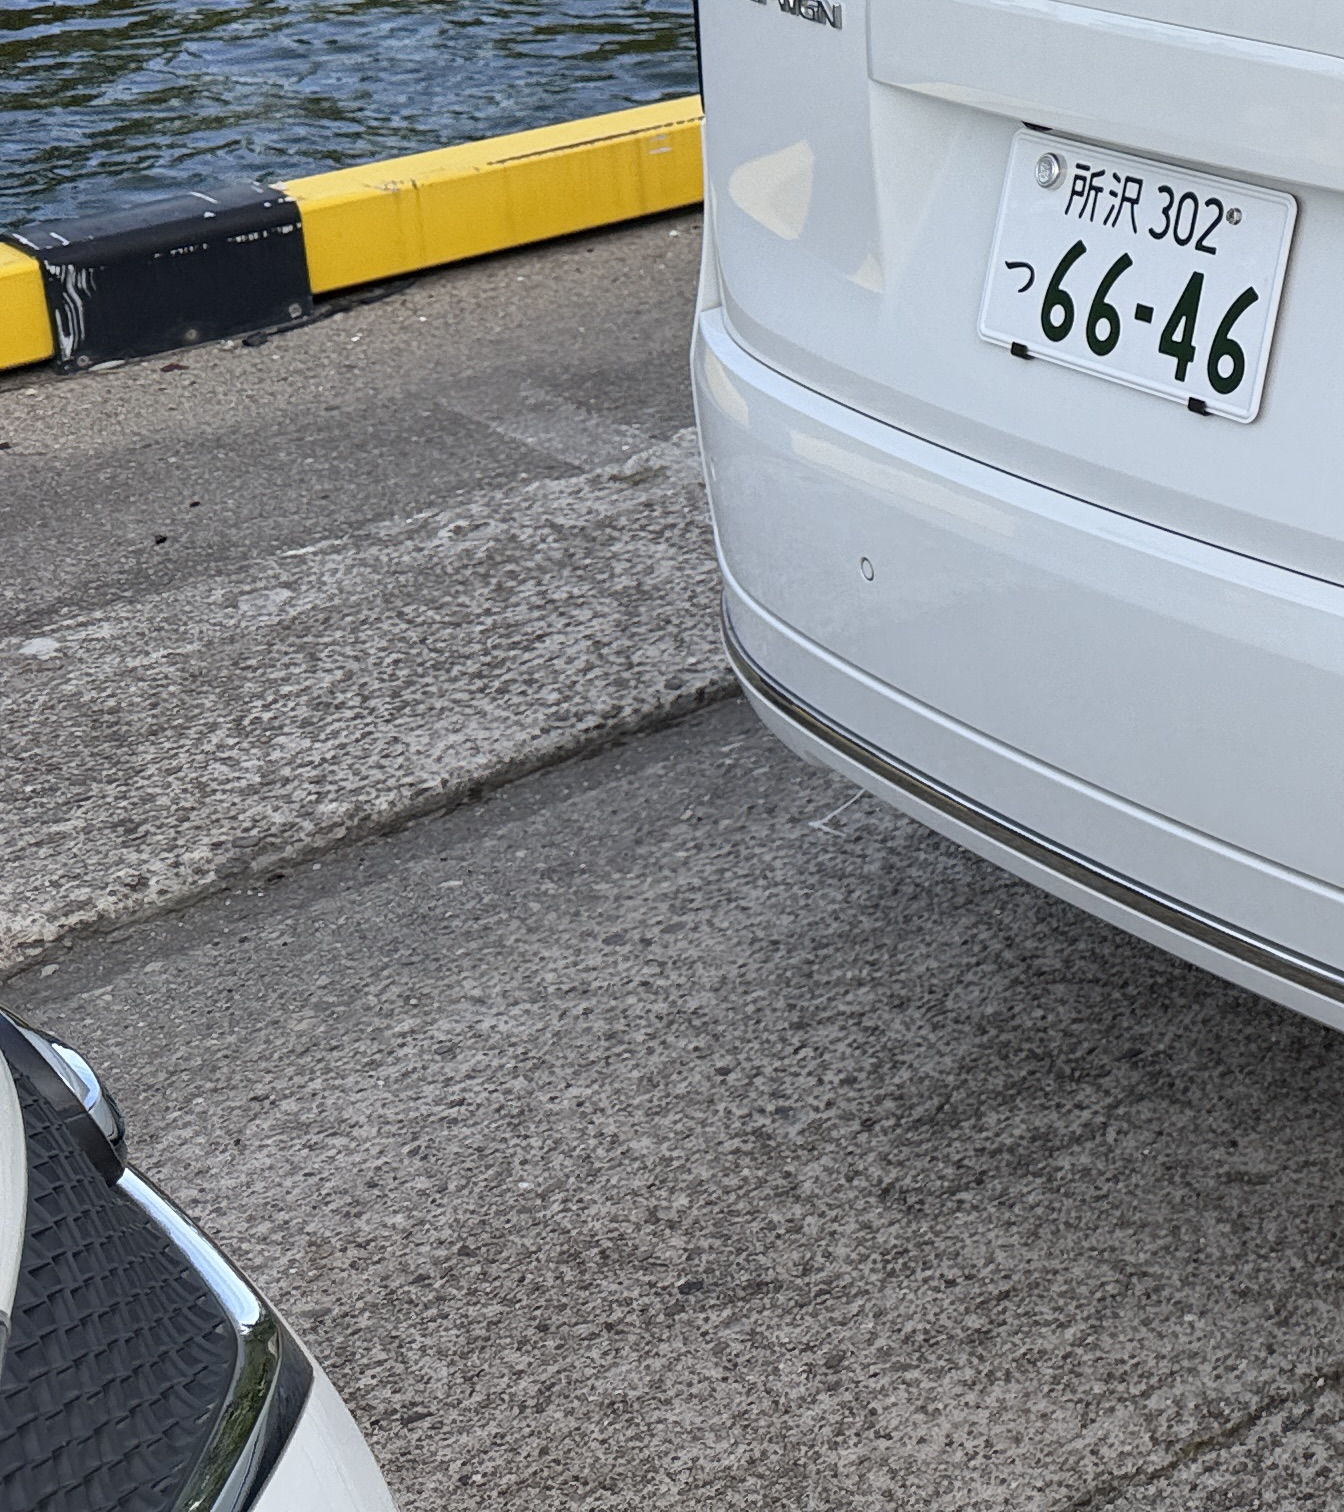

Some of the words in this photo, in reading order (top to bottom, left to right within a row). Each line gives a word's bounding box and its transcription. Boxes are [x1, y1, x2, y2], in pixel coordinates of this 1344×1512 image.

[1065, 162, 1143, 234] 所沢
[1148, 185, 1224, 255] 302
[1040, 239, 1259, 394] 66-46
